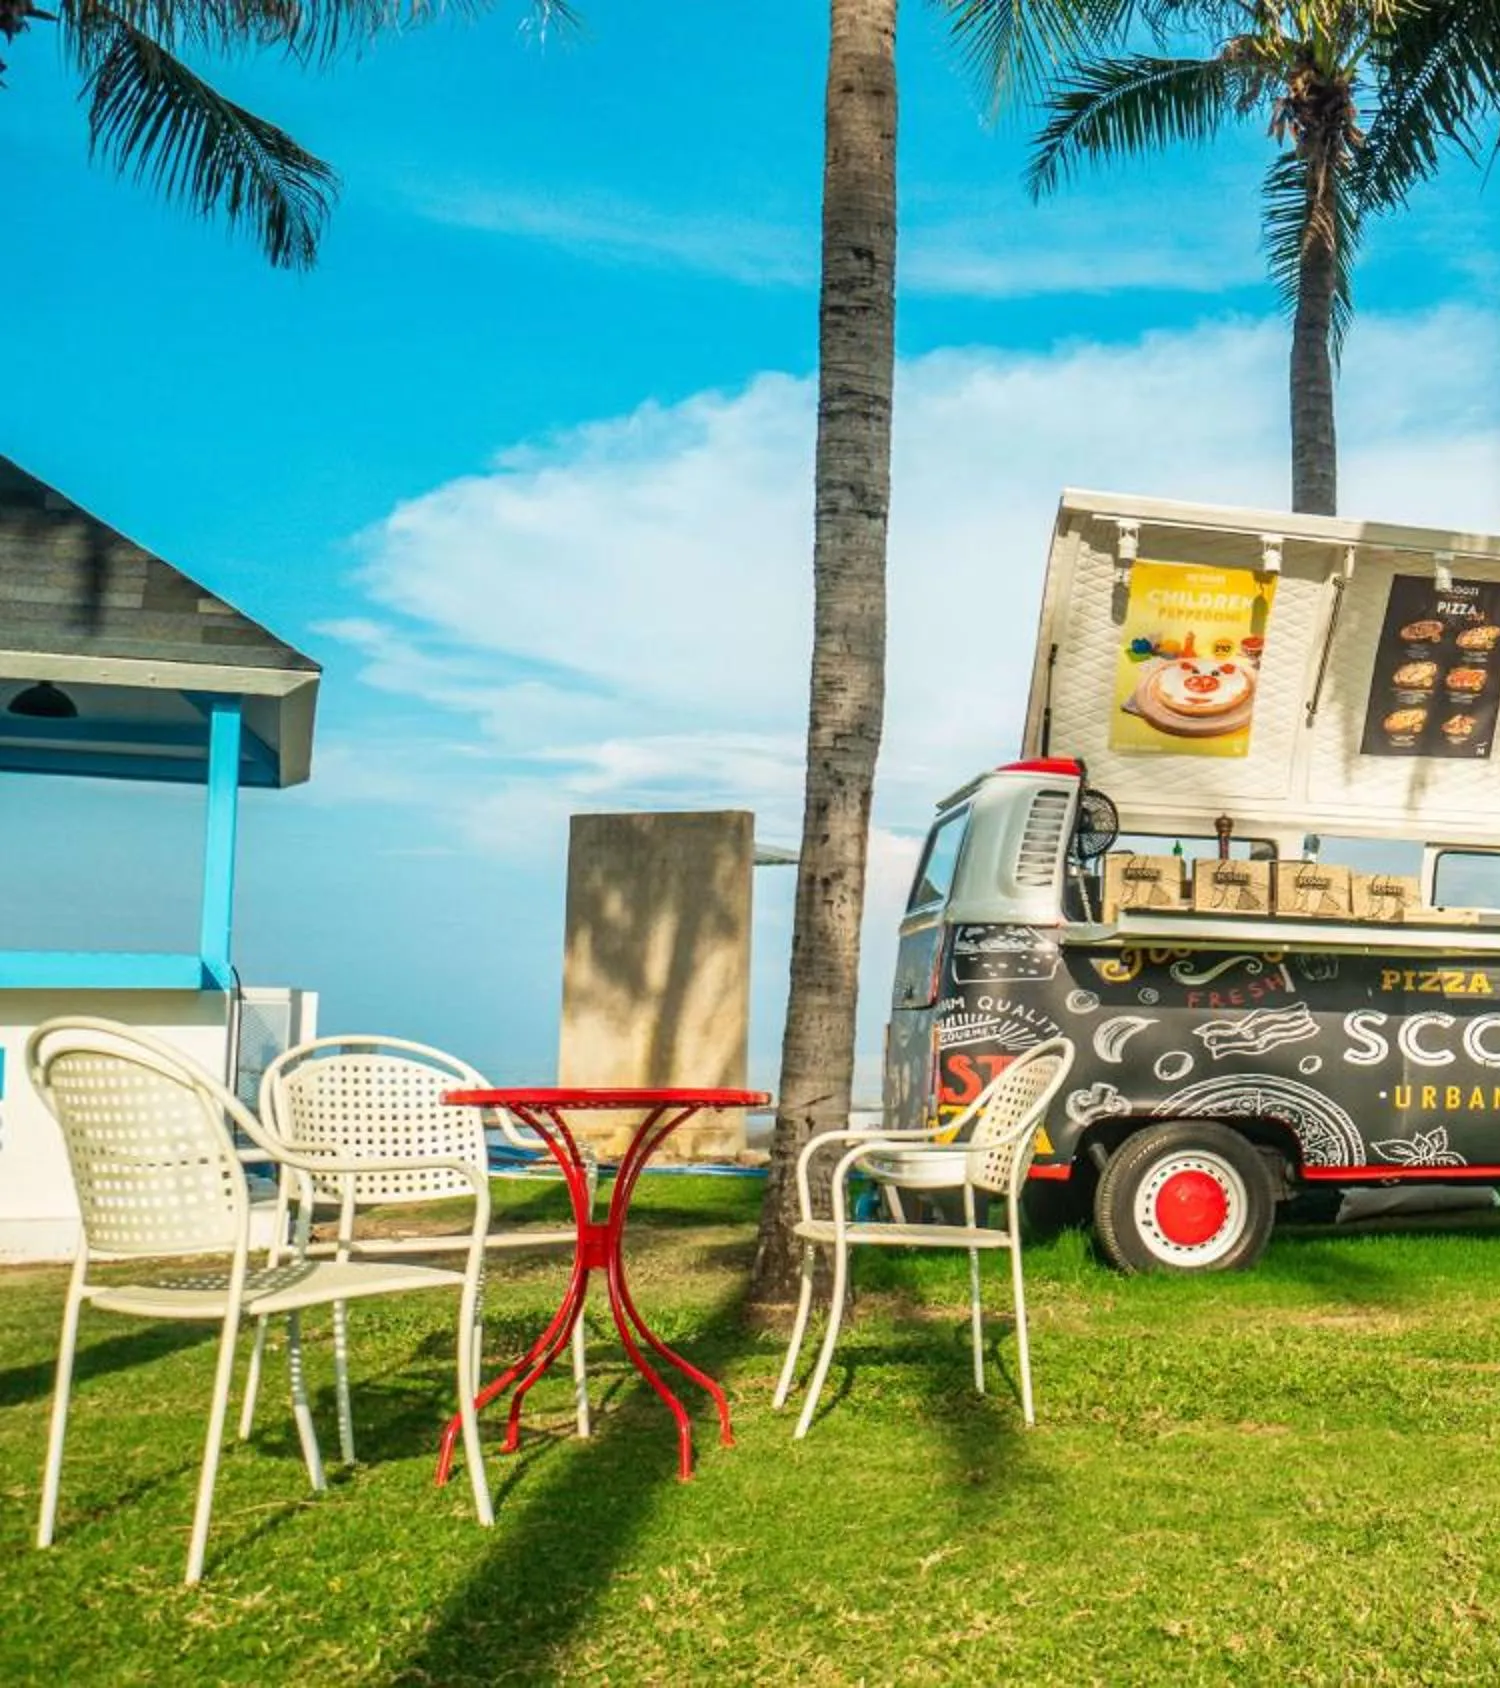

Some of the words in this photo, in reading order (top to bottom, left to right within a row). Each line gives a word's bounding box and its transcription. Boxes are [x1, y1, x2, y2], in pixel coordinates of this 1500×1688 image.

[1147, 589, 1254, 610] CHILDREN
[1437, 601, 1478, 615] PIZZA
[1187, 972, 1285, 1009] FRESH
[1381, 968, 1493, 993] PIZZA
[977, 995, 1065, 1039] QUALITY
[940, 1025, 999, 1043] GOURMET
